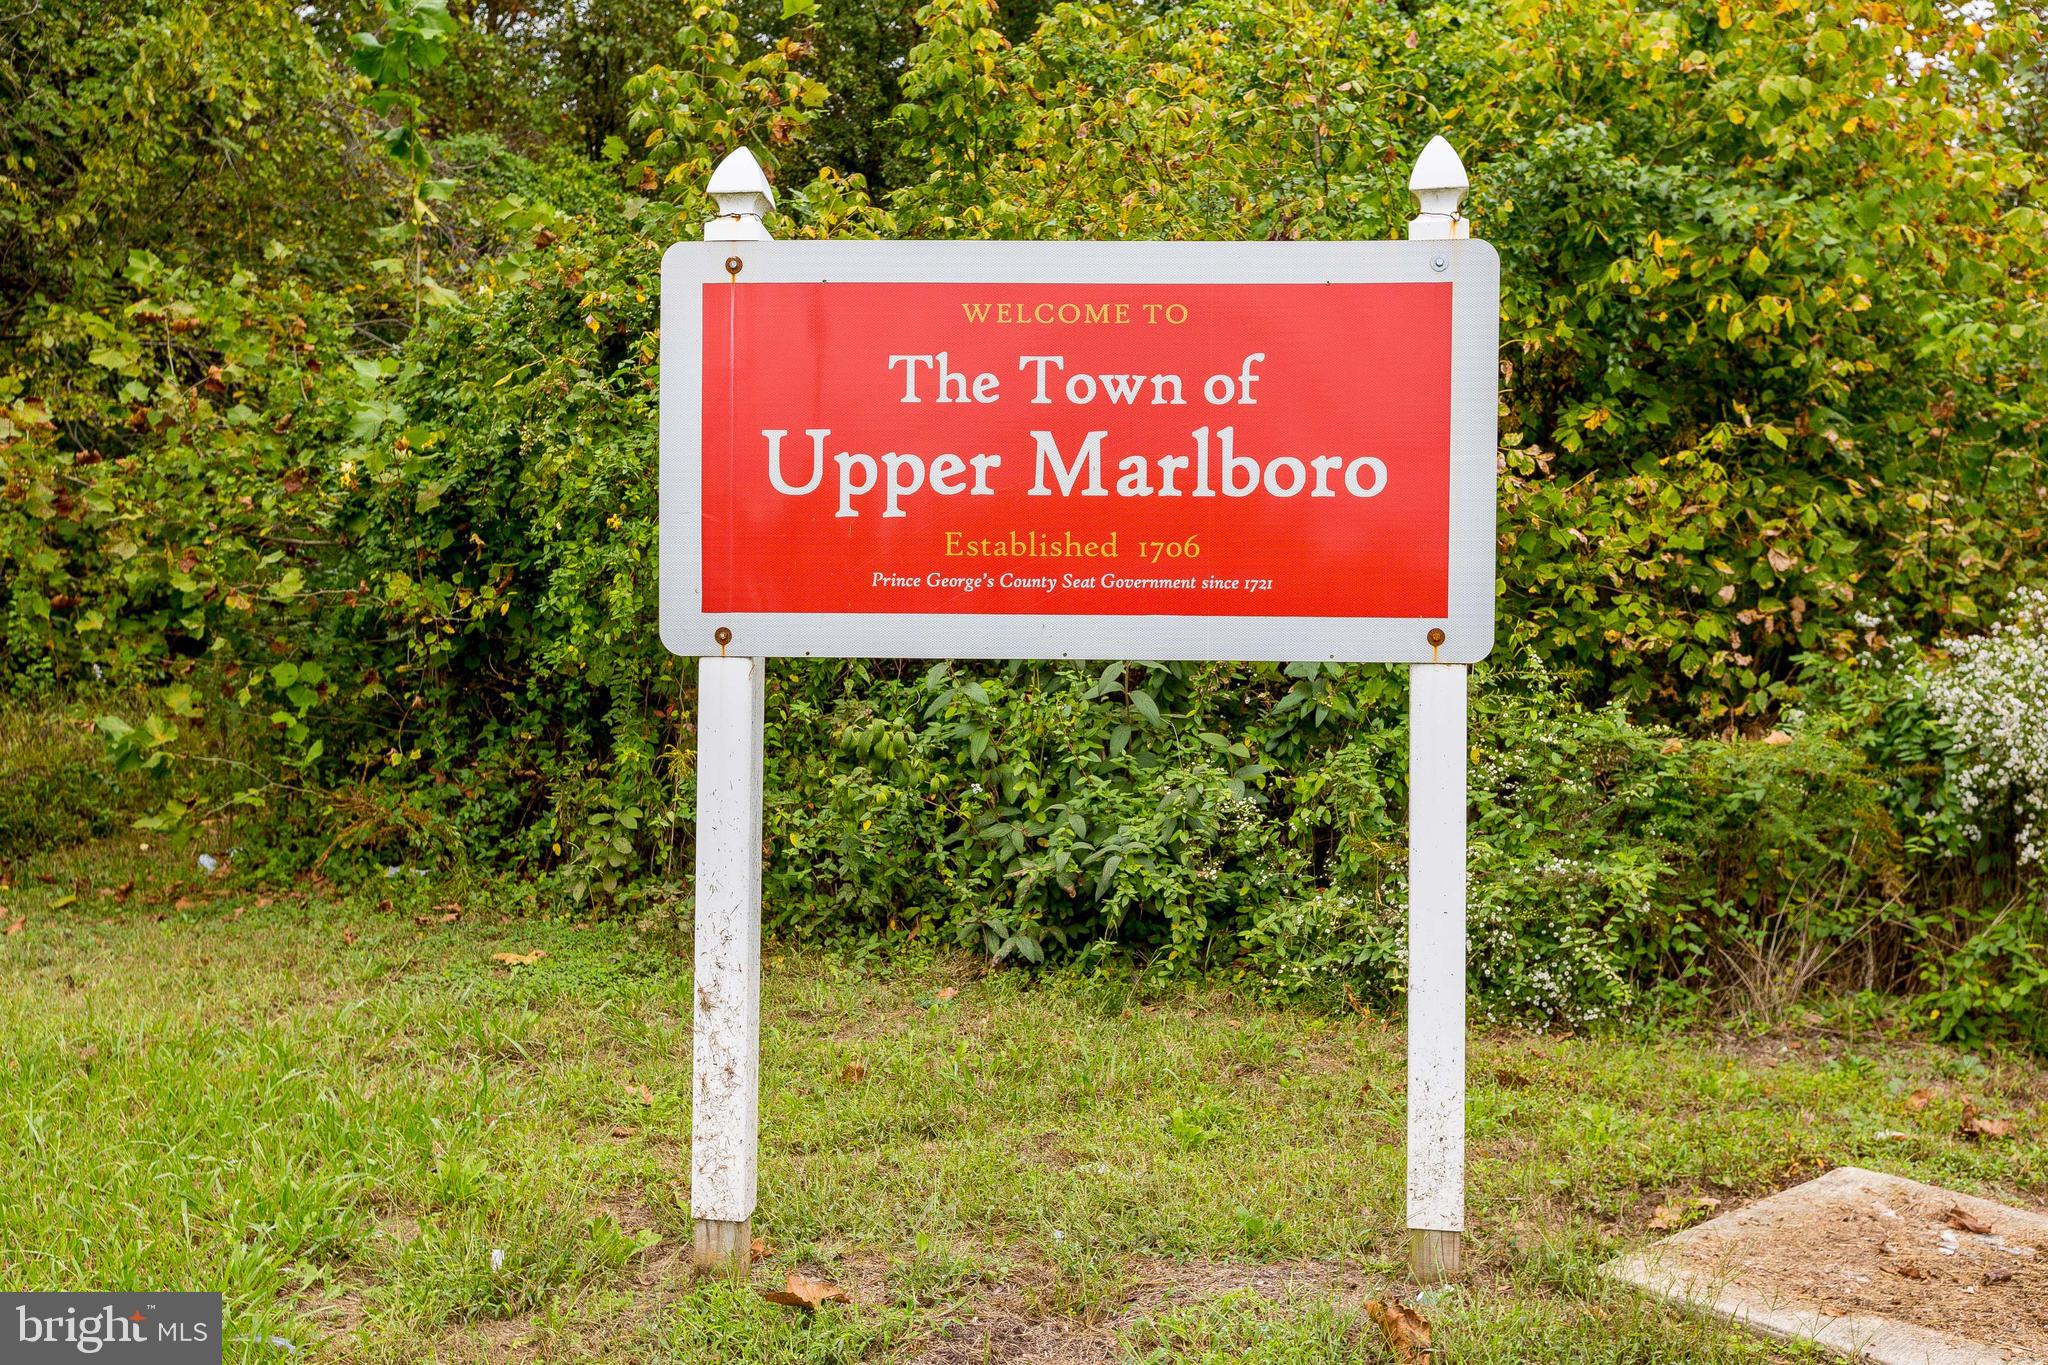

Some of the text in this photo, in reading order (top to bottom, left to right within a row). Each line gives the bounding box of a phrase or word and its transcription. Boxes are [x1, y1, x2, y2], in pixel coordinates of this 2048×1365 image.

[961, 303, 1189, 325] WELCOME TO
[888, 351, 1266, 405] The Town of
[761, 425, 1388, 518] Upper Marlboro
[944, 531, 1201, 563] Established 1706
[871, 572, 1273, 593] Prince George's County Seat Government since 1721
